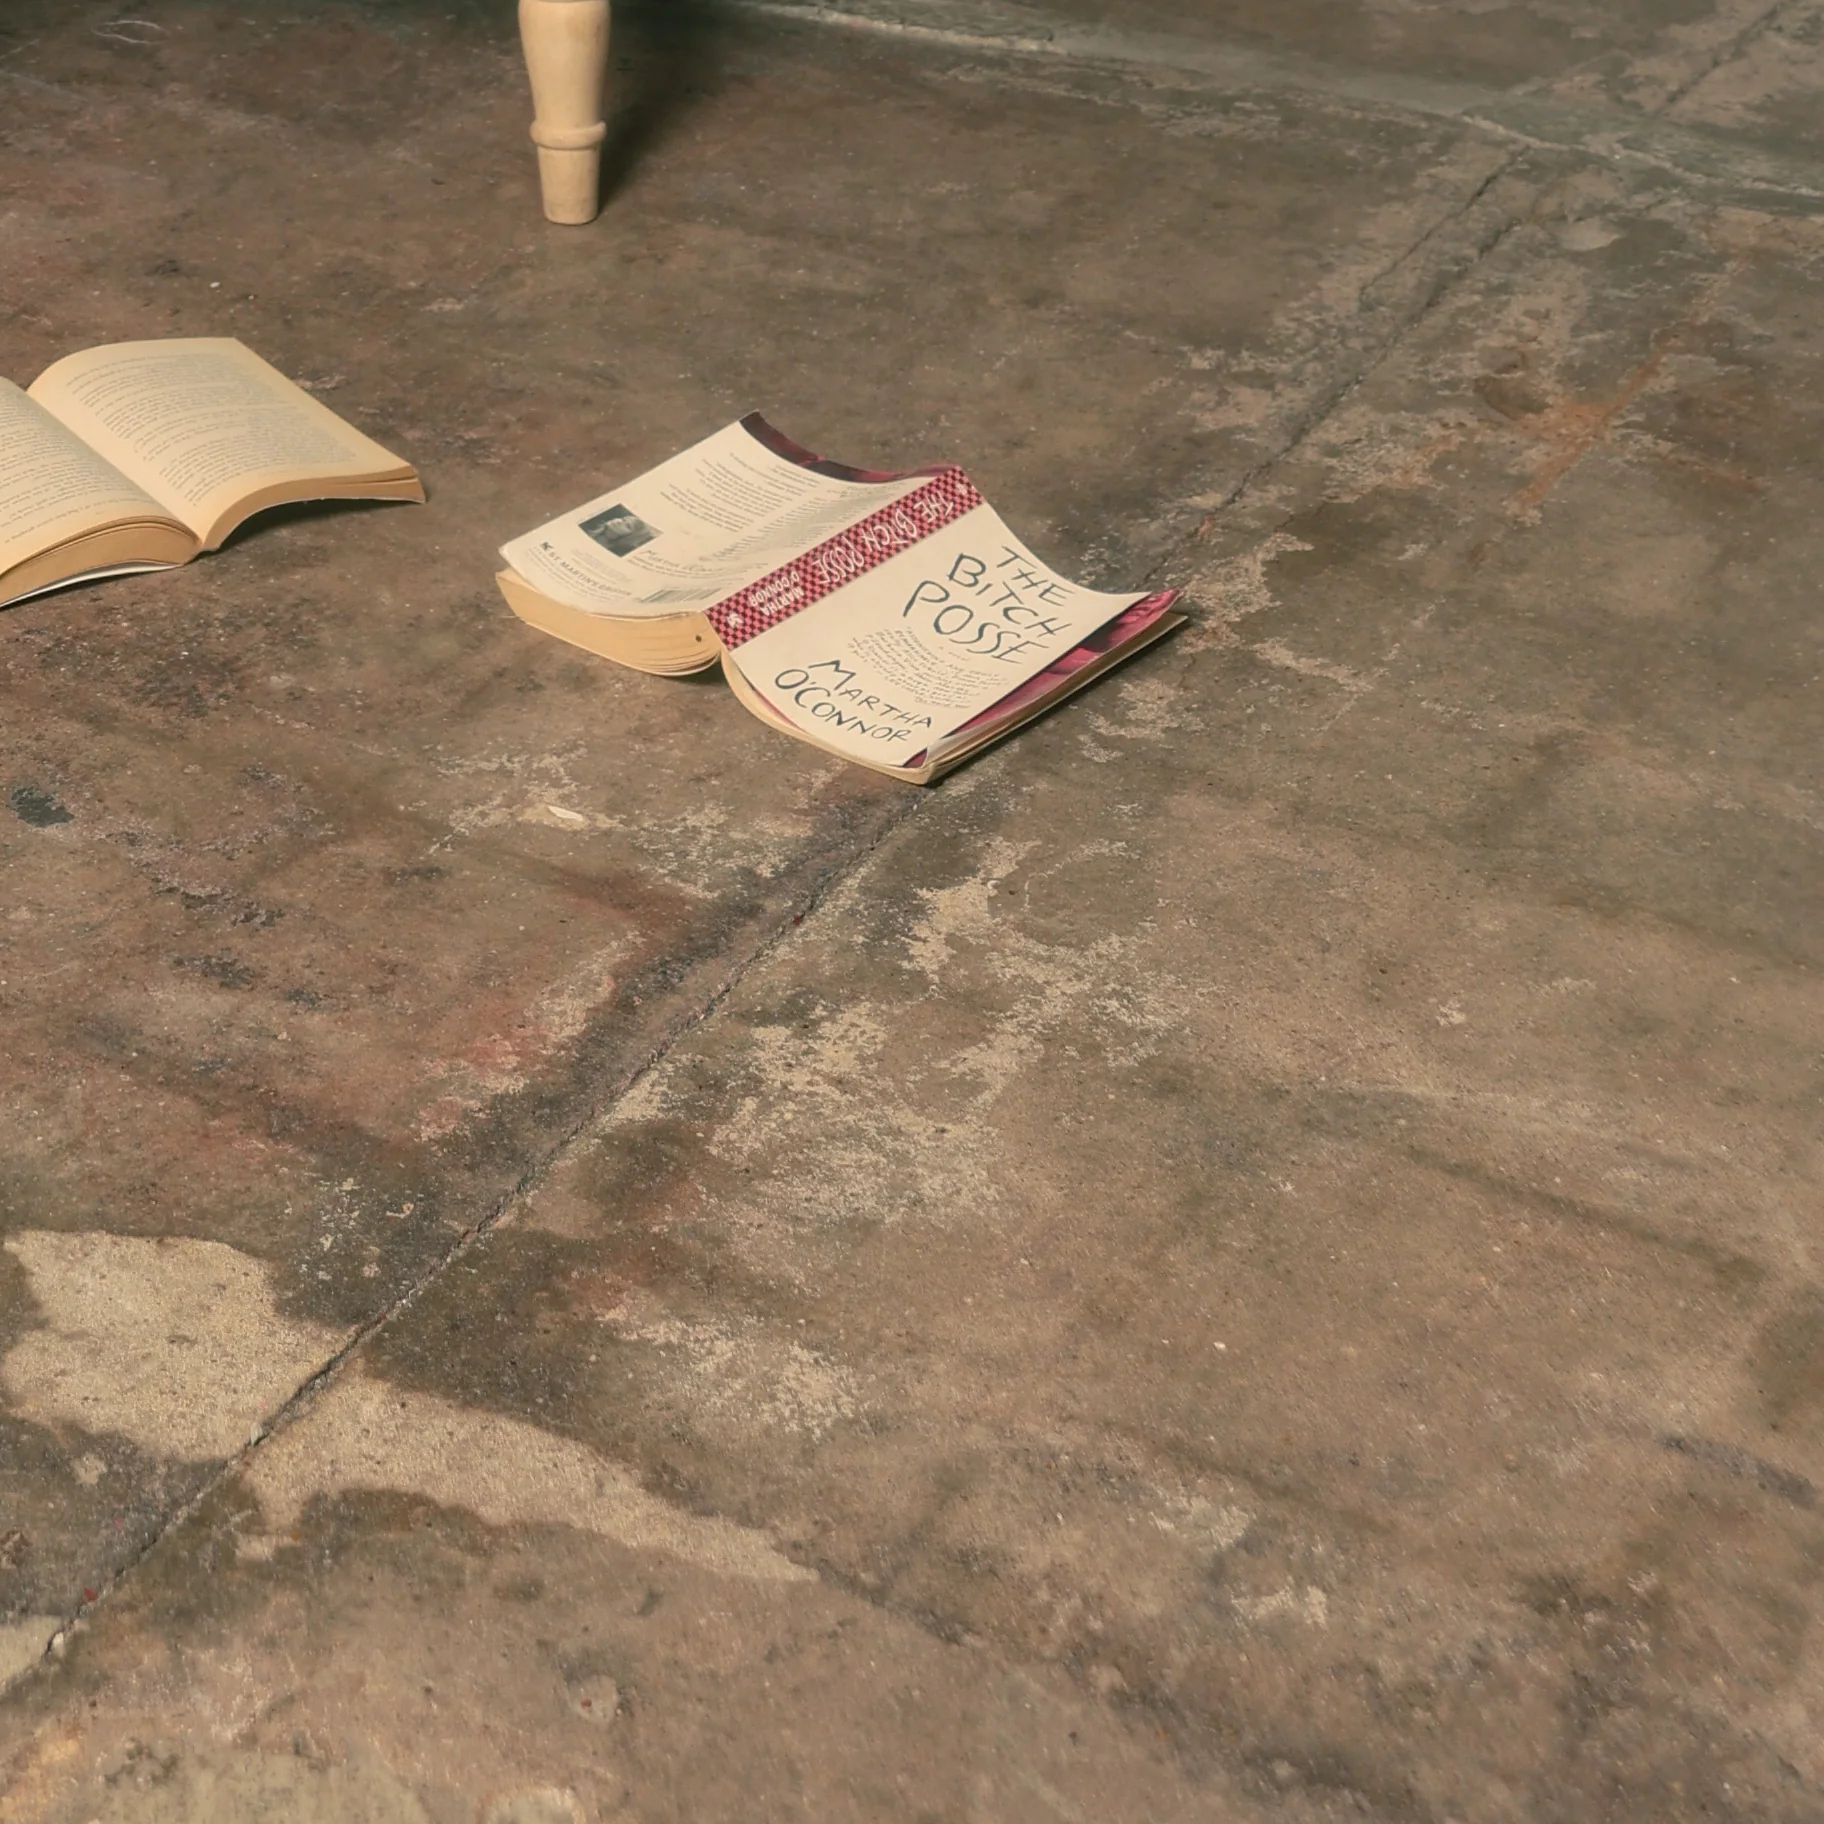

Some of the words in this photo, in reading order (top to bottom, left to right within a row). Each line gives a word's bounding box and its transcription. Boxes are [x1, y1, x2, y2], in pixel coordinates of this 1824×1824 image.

[861, 508, 917, 551] BITCH
[912, 489, 954, 523] THE
[811, 535, 864, 584] POSSE
[996, 544, 1076, 607] THE
[748, 571, 800, 607] O'CONNOR
[759, 586, 805, 616] MARTHA
[946, 552, 1073, 639] BITCH
[903, 580, 1050, 664] POSSE
[774, 667, 911, 743] O'CONNOR
[808, 659, 934, 729] MARTHA
